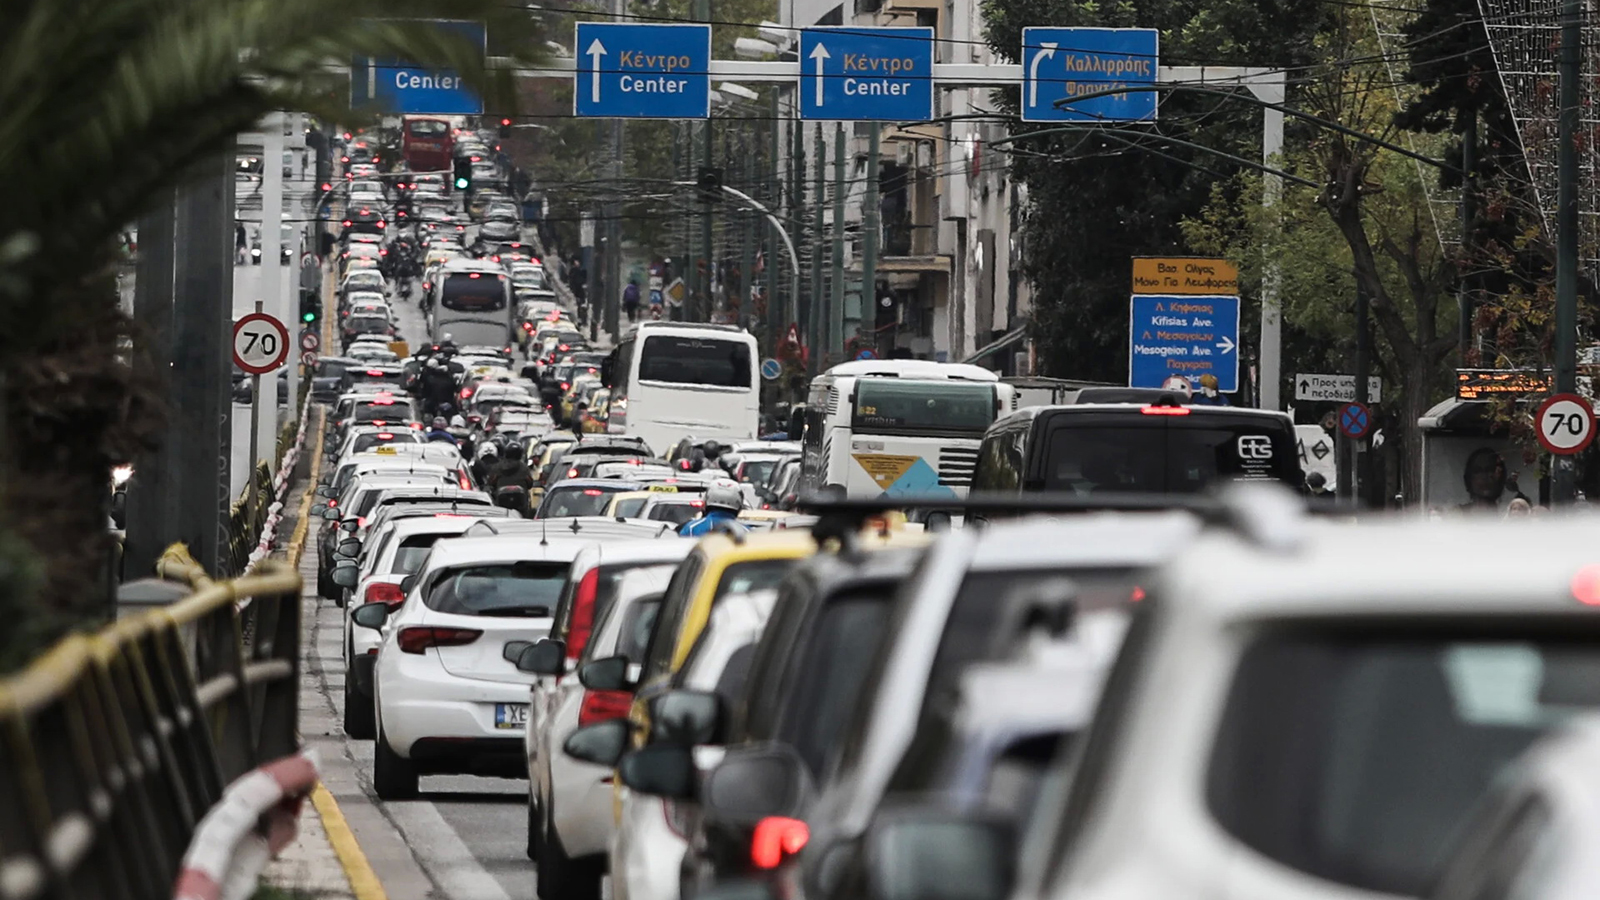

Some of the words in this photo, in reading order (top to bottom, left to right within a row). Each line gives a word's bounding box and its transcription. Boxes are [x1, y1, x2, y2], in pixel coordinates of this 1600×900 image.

[619, 49, 691, 73] Κέντρο
[843, 52, 914, 75] Κέντρο
[1065, 54, 1151, 77] Καλλιρρόης
[395, 71, 462, 90] Center
[619, 75, 688, 94] Center
[843, 78, 911, 97] Center
[1151, 315, 1188, 326] Kifisias
[1192, 317, 1214, 327] Ave.
[242, 331, 277, 356] 70
[1134, 344, 1188, 357] Mesogeion
[1192, 345, 1213, 356] Ave.
[1312, 377, 1337, 388] Προς
[1549, 412, 1584, 436] 70
